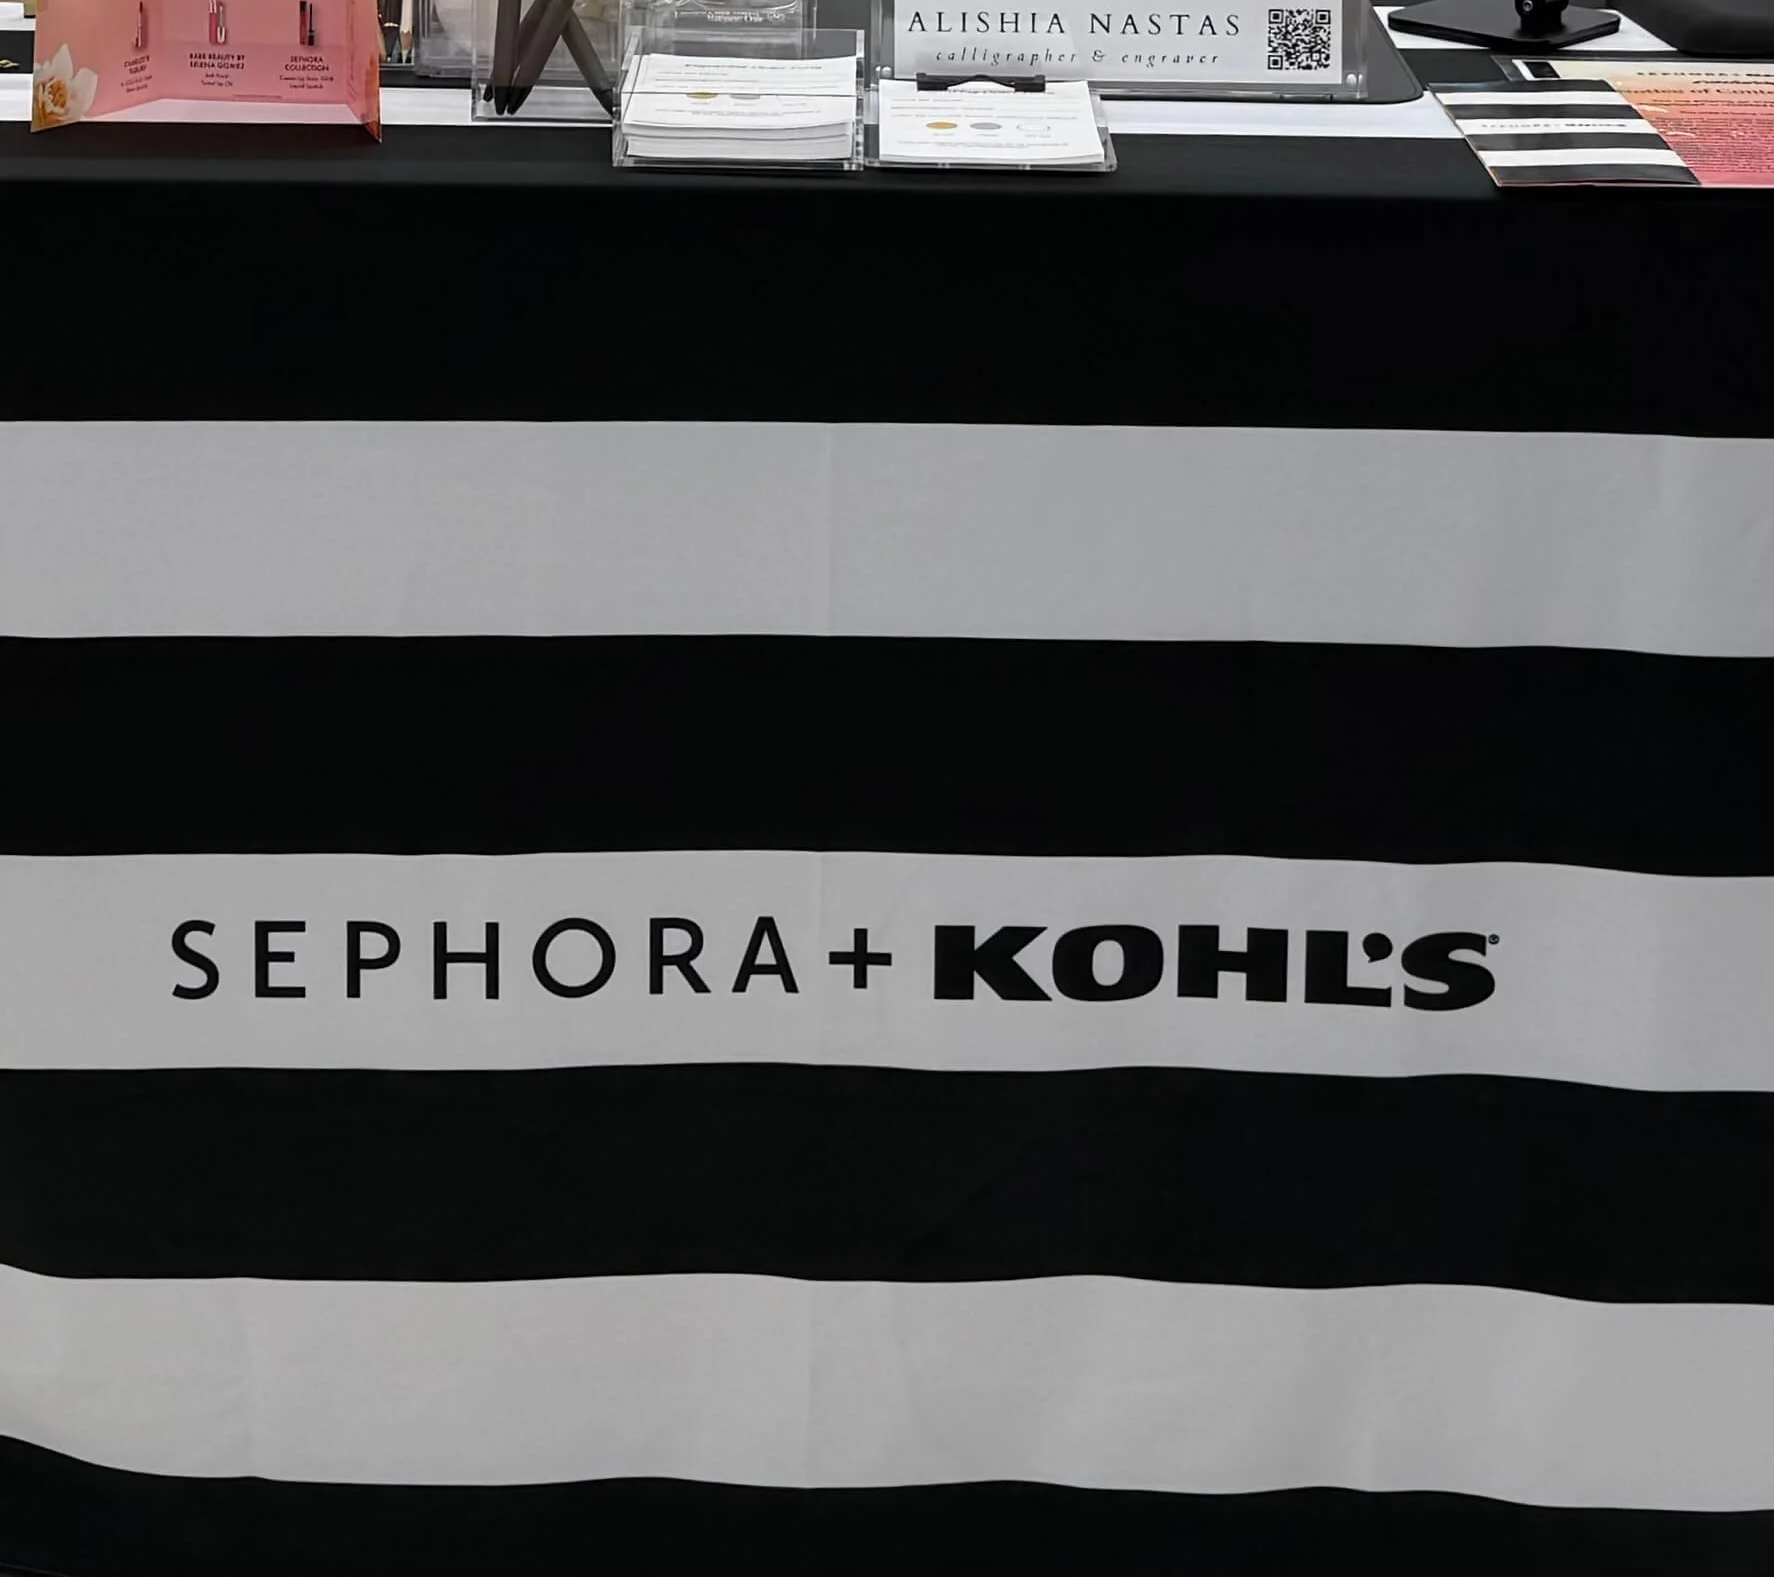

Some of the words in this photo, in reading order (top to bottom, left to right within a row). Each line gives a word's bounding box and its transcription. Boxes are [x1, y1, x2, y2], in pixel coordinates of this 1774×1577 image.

[908, 11, 1065, 34] ALISHIA
[1089, 13, 1240, 36] NASTAS
[936, 47, 1077, 66] calligrapher
[1091, 50, 1106, 62] &
[1121, 53, 1218, 68] engraver
[172, 917, 802, 1000] SEPHORA
[934, 925, 1500, 1013] KOHL'S
